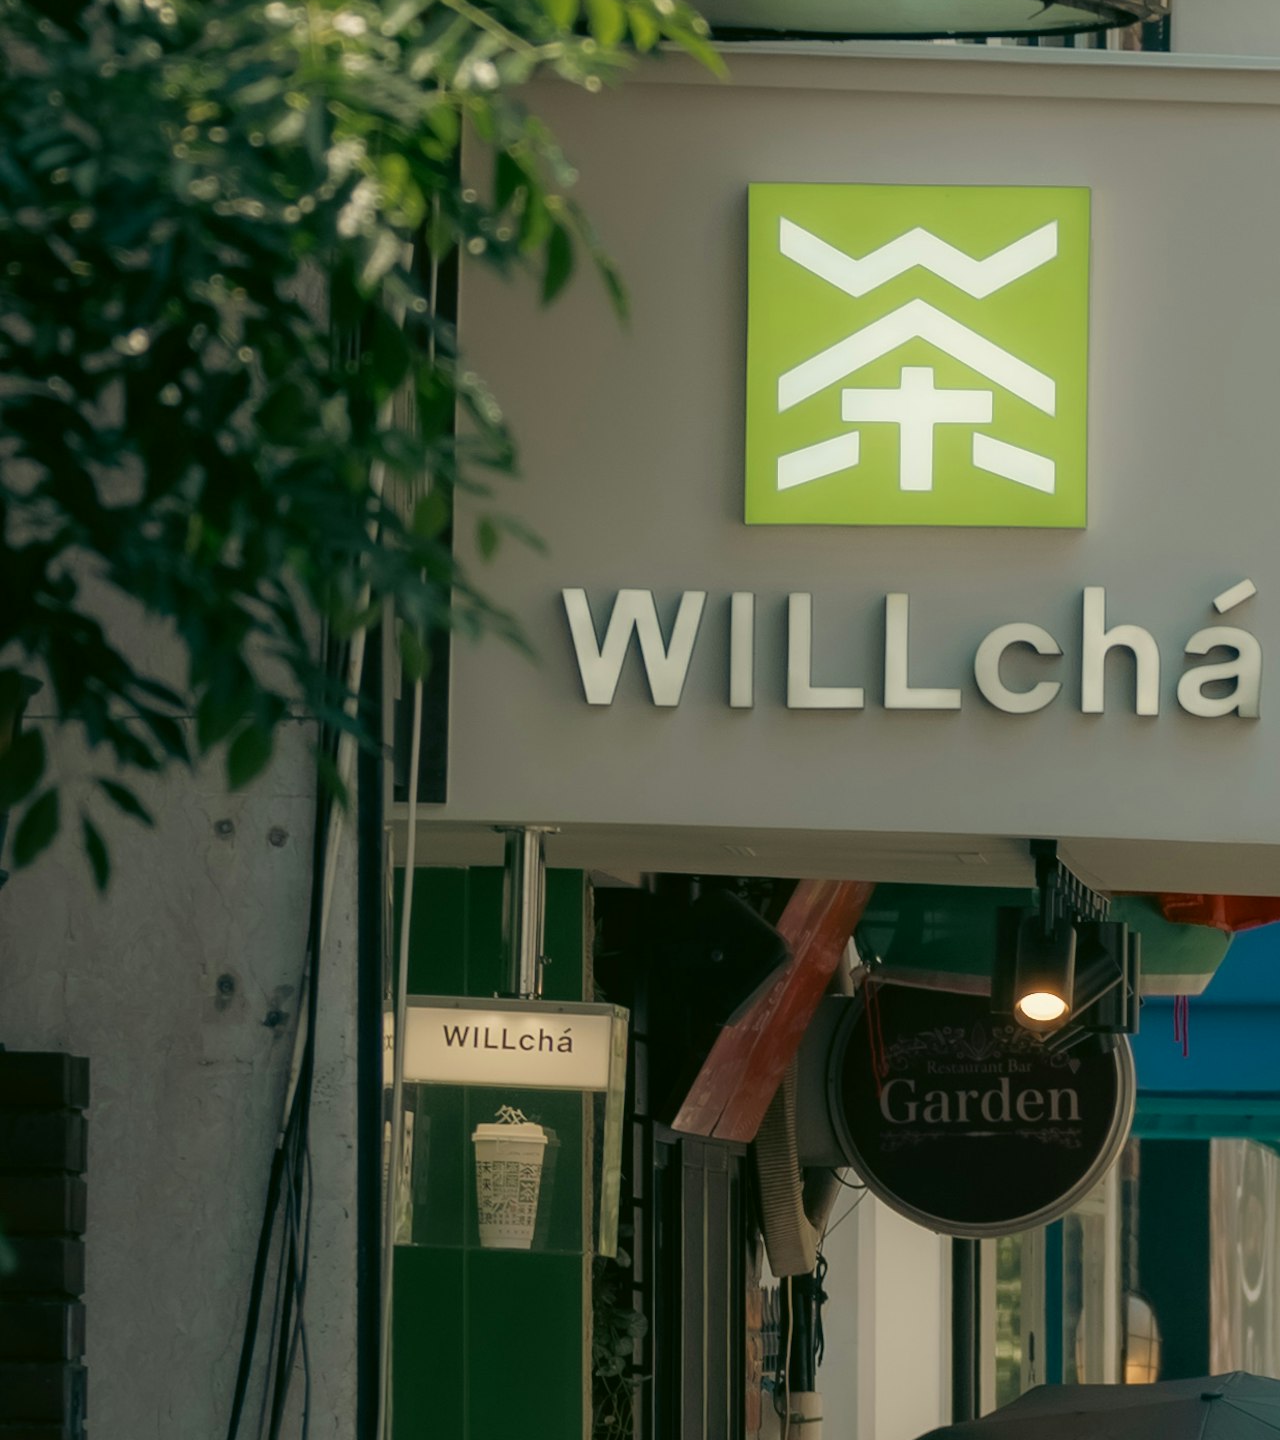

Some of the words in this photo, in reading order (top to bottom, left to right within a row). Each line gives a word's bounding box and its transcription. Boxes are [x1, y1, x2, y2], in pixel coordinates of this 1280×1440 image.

[561, 579, 1262, 719] WILLchá
[443, 1024, 574, 1053] WILLchá
[927, 1060, 1003, 1074] Restaurant
[1008, 1058, 1032, 1073] Bar
[880, 1076, 1082, 1124] Garden
